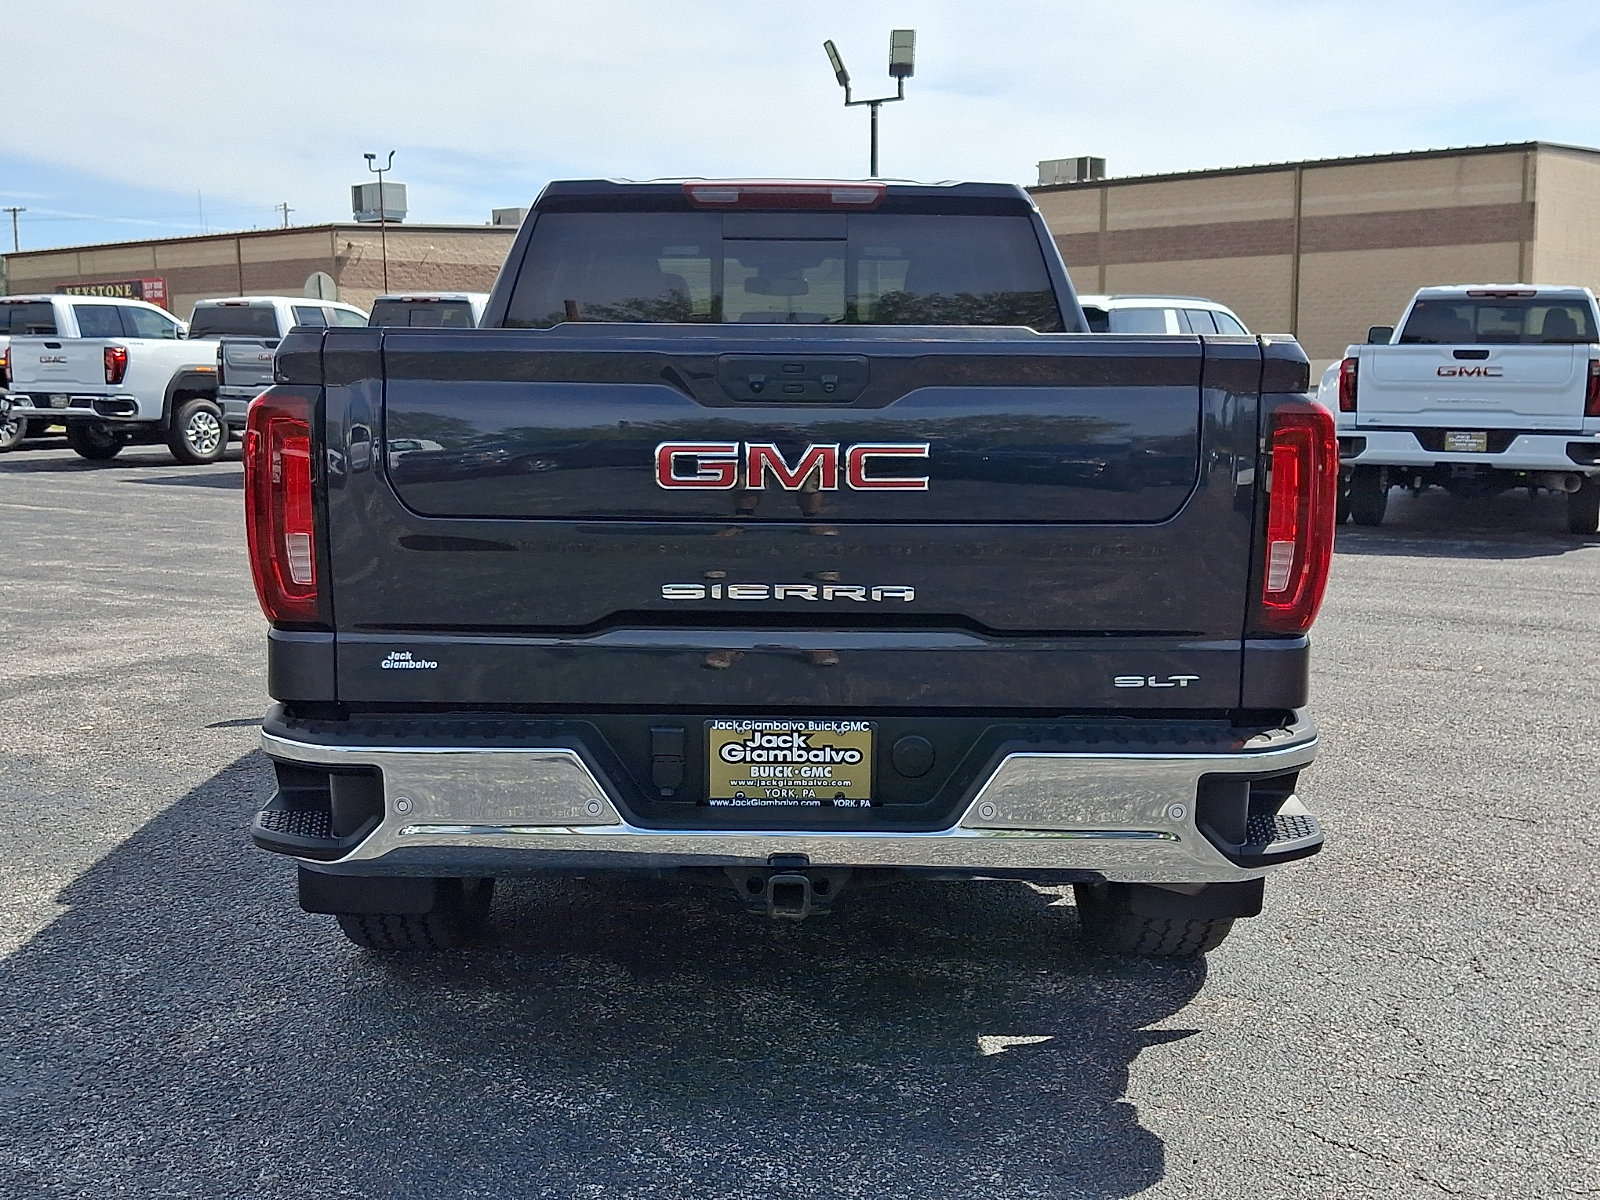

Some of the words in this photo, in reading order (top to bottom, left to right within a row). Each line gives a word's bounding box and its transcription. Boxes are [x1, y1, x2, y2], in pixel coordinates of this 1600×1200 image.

[66, 284, 132, 296] KEYSTONE
[1437, 366, 1503, 377] GMC
[654, 441, 930, 492] GMC
[661, 583, 916, 602] SIERRA
[387, 651, 413, 660] Jack
[381, 660, 438, 669] Giambalvo
[1114, 675, 1200, 687] SLT
[711, 720, 738, 730] Jack
[742, 720, 805, 731] Giambalvo
[808, 721, 838, 731] Buick
[840, 721, 870, 731] GMC
[745, 732, 807, 748] Jack
[720, 743, 861, 763] Giambalvo
[750, 766, 793, 777] BUICK
[800, 766, 832, 777] GMC
[730, 779, 852, 787] www.jackgiambalvo.com
[764, 788, 799, 799] YORK,
[802, 789, 816, 798] PA
[709, 799, 821, 807] www.JackGiambalvocom
[860, 800, 871, 808] PA
